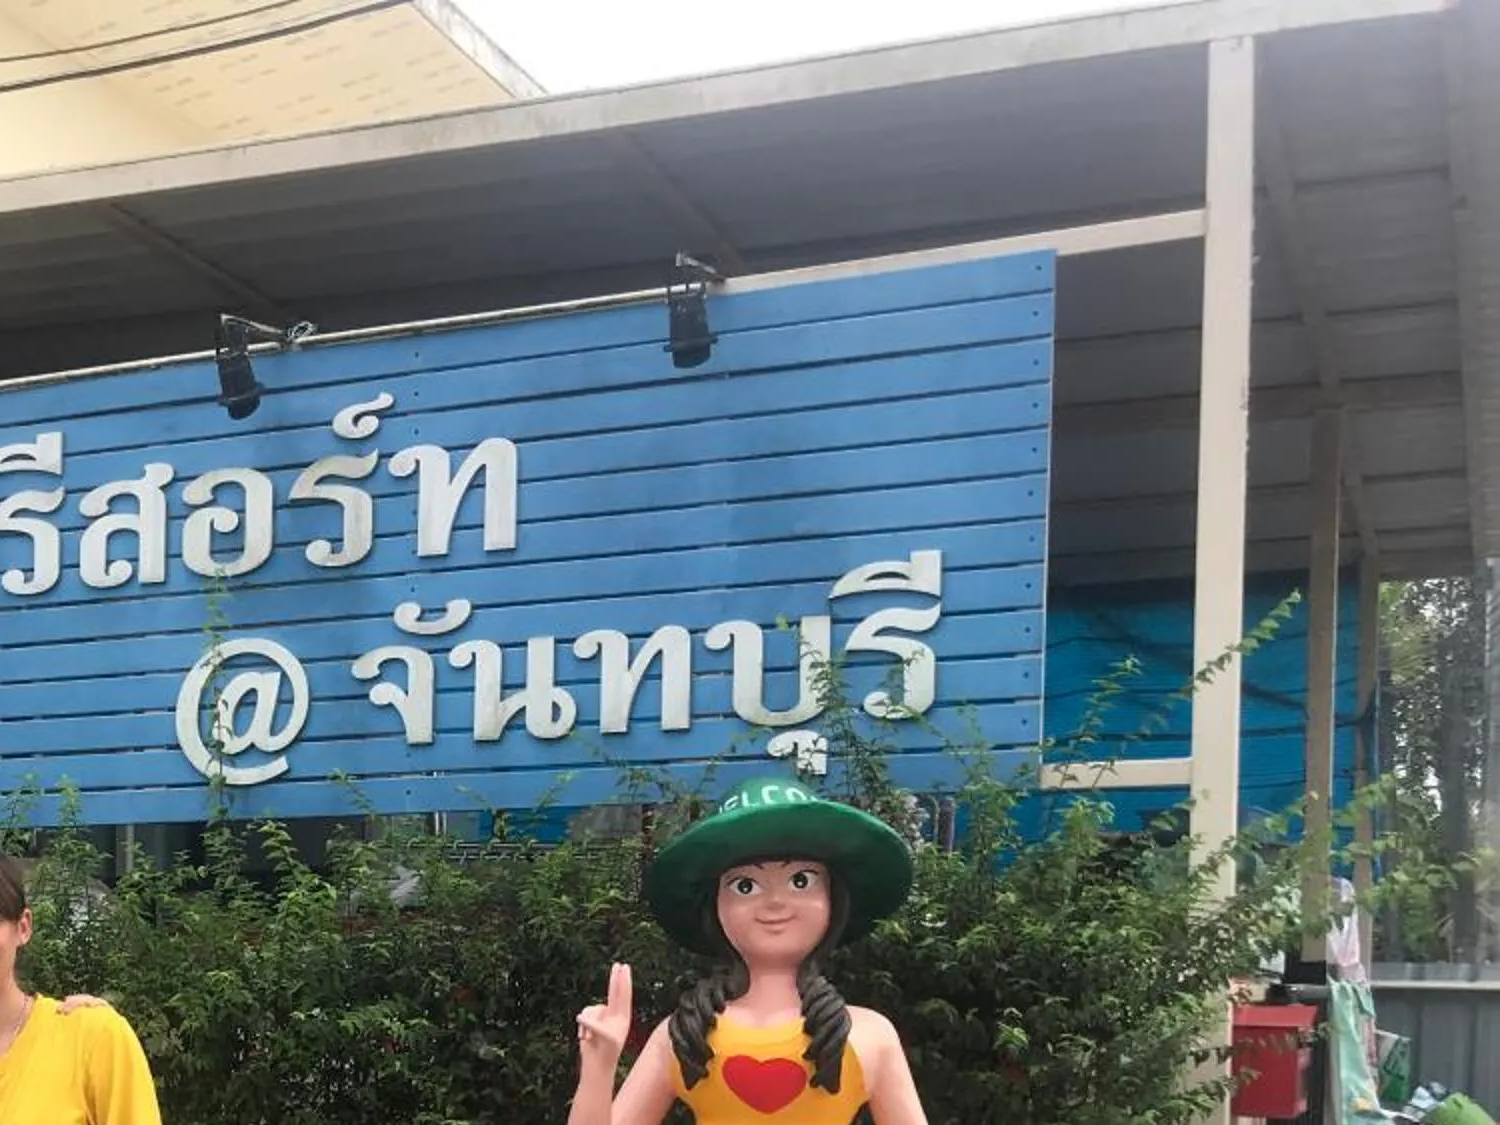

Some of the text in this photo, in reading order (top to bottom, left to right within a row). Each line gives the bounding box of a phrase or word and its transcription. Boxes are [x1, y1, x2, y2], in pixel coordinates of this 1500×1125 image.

[174, 548, 943, 786] @ จันทบุรี
